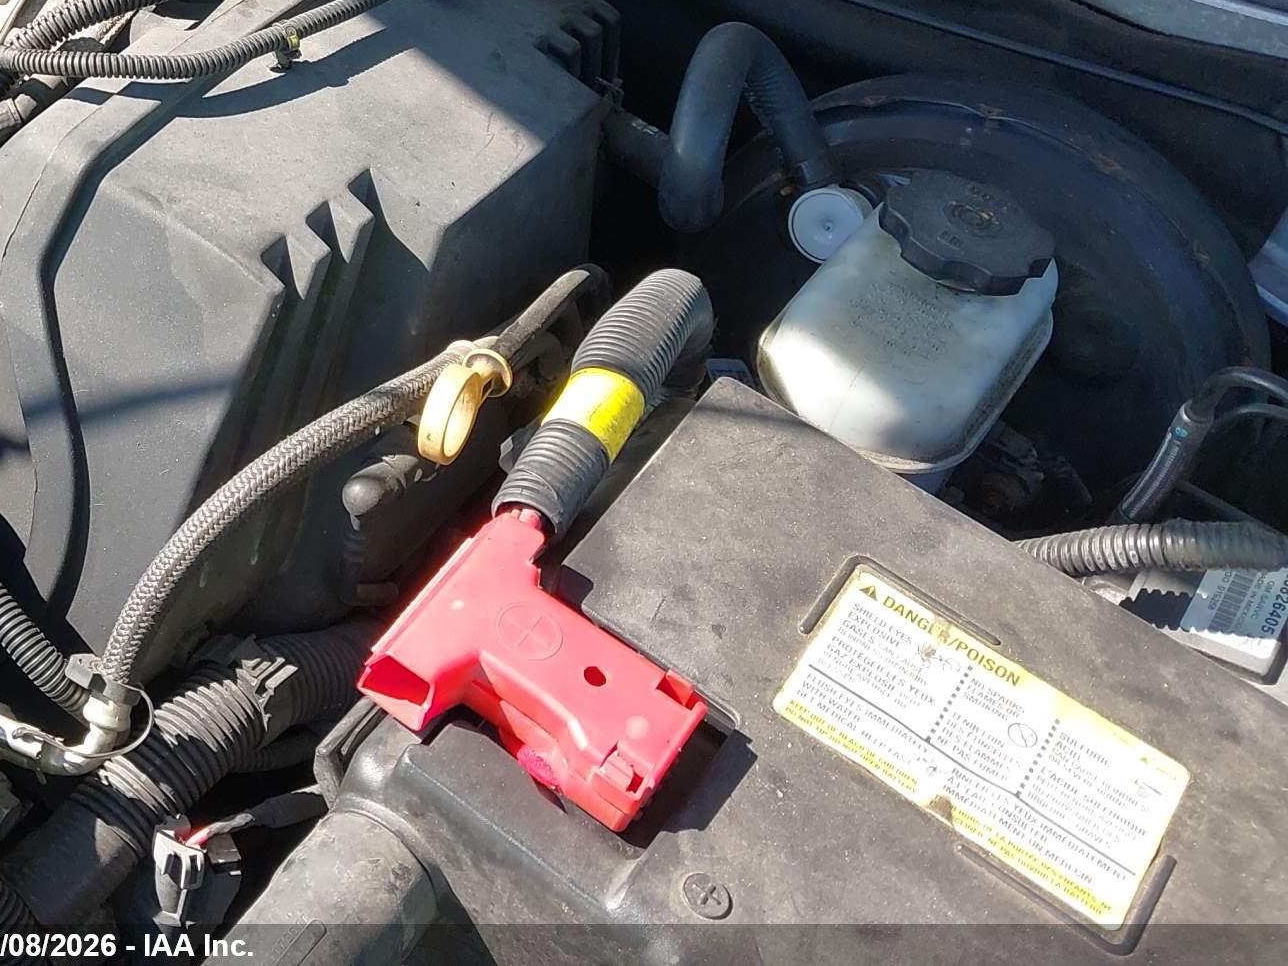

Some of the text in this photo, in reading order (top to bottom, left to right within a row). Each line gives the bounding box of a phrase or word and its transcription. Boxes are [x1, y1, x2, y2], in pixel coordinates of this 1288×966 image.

[841, 617, 877, 645] GASES
[881, 594, 1021, 687] DANGER/POISON
[906, 683, 937, 707] YEUX
[969, 676, 986, 691] NO
